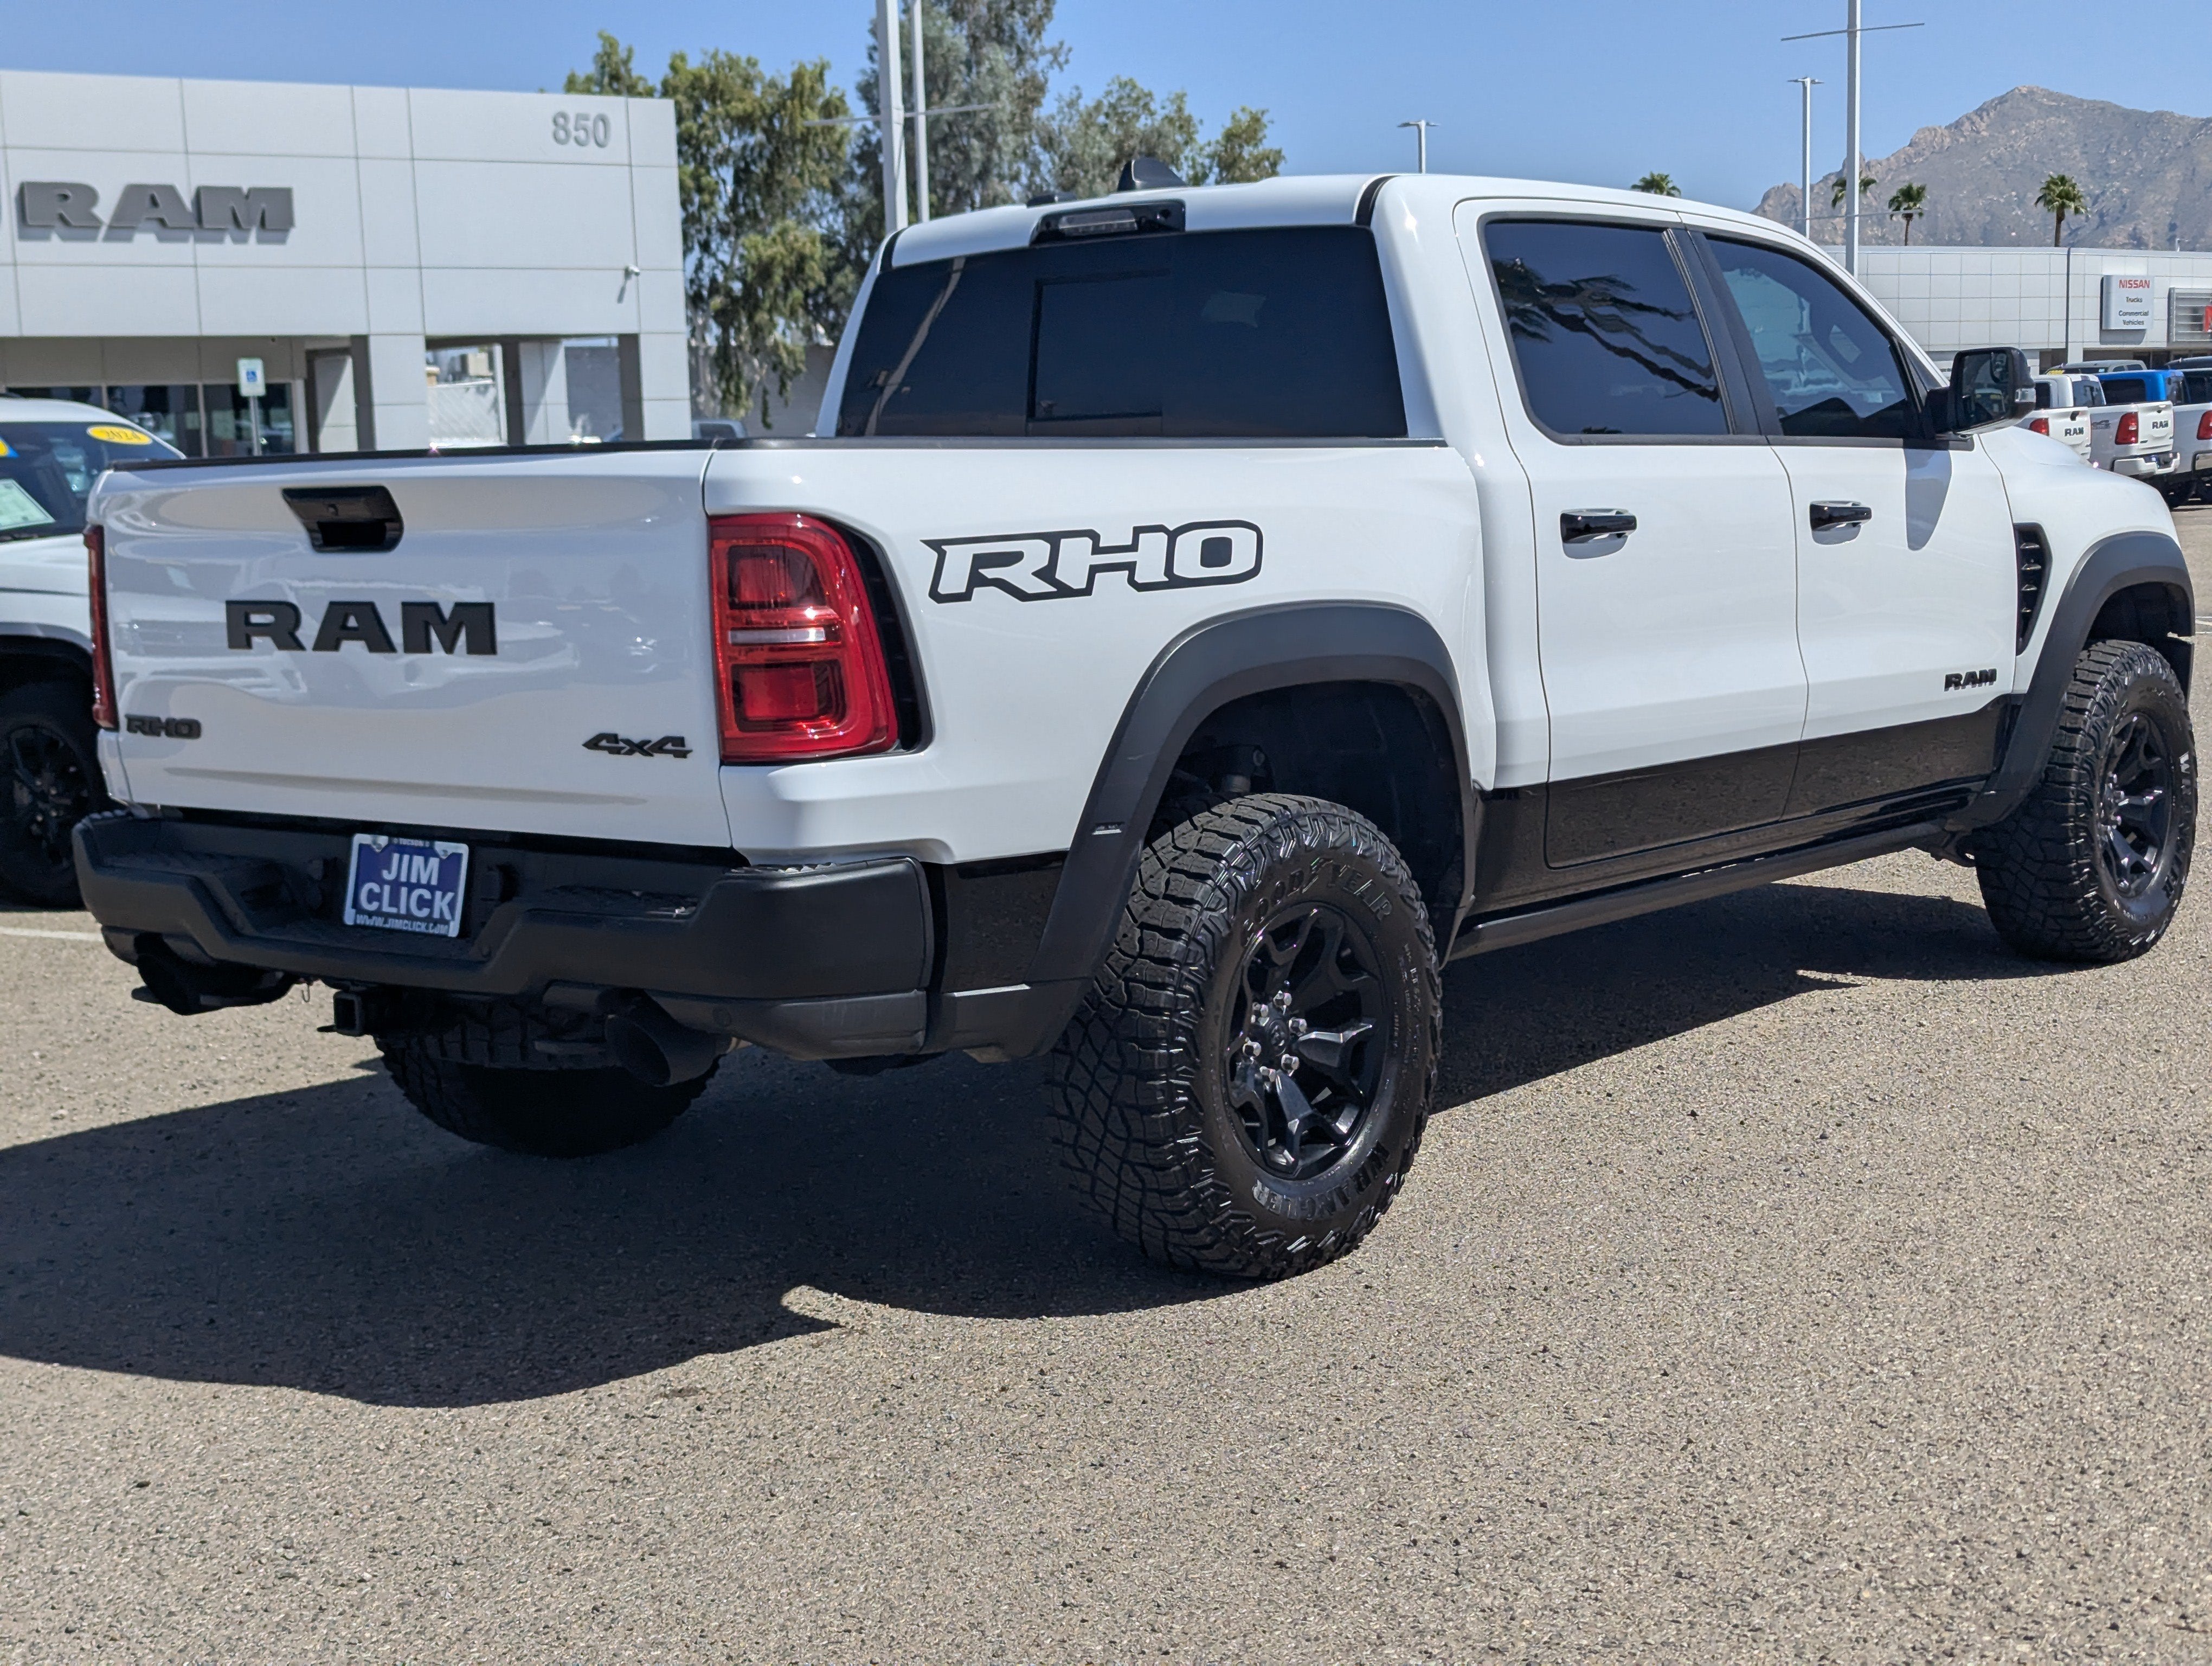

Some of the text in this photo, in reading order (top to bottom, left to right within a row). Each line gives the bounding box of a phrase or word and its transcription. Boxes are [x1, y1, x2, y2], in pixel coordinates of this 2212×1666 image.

[552, 111, 610, 149] 850
[19, 181, 295, 230] RAM
[2119, 279, 2150, 289] NISSAN
[2065, 427, 2084, 437] RAM
[2152, 420, 2169, 430] RAM
[921, 520, 1263, 604] RHO
[225, 600, 497, 656] RAM
[1944, 668, 1997, 690] RAM
[125, 714, 202, 739] RHO
[382, 852, 440, 886] JIM
[360, 882, 455, 920] CLICK
